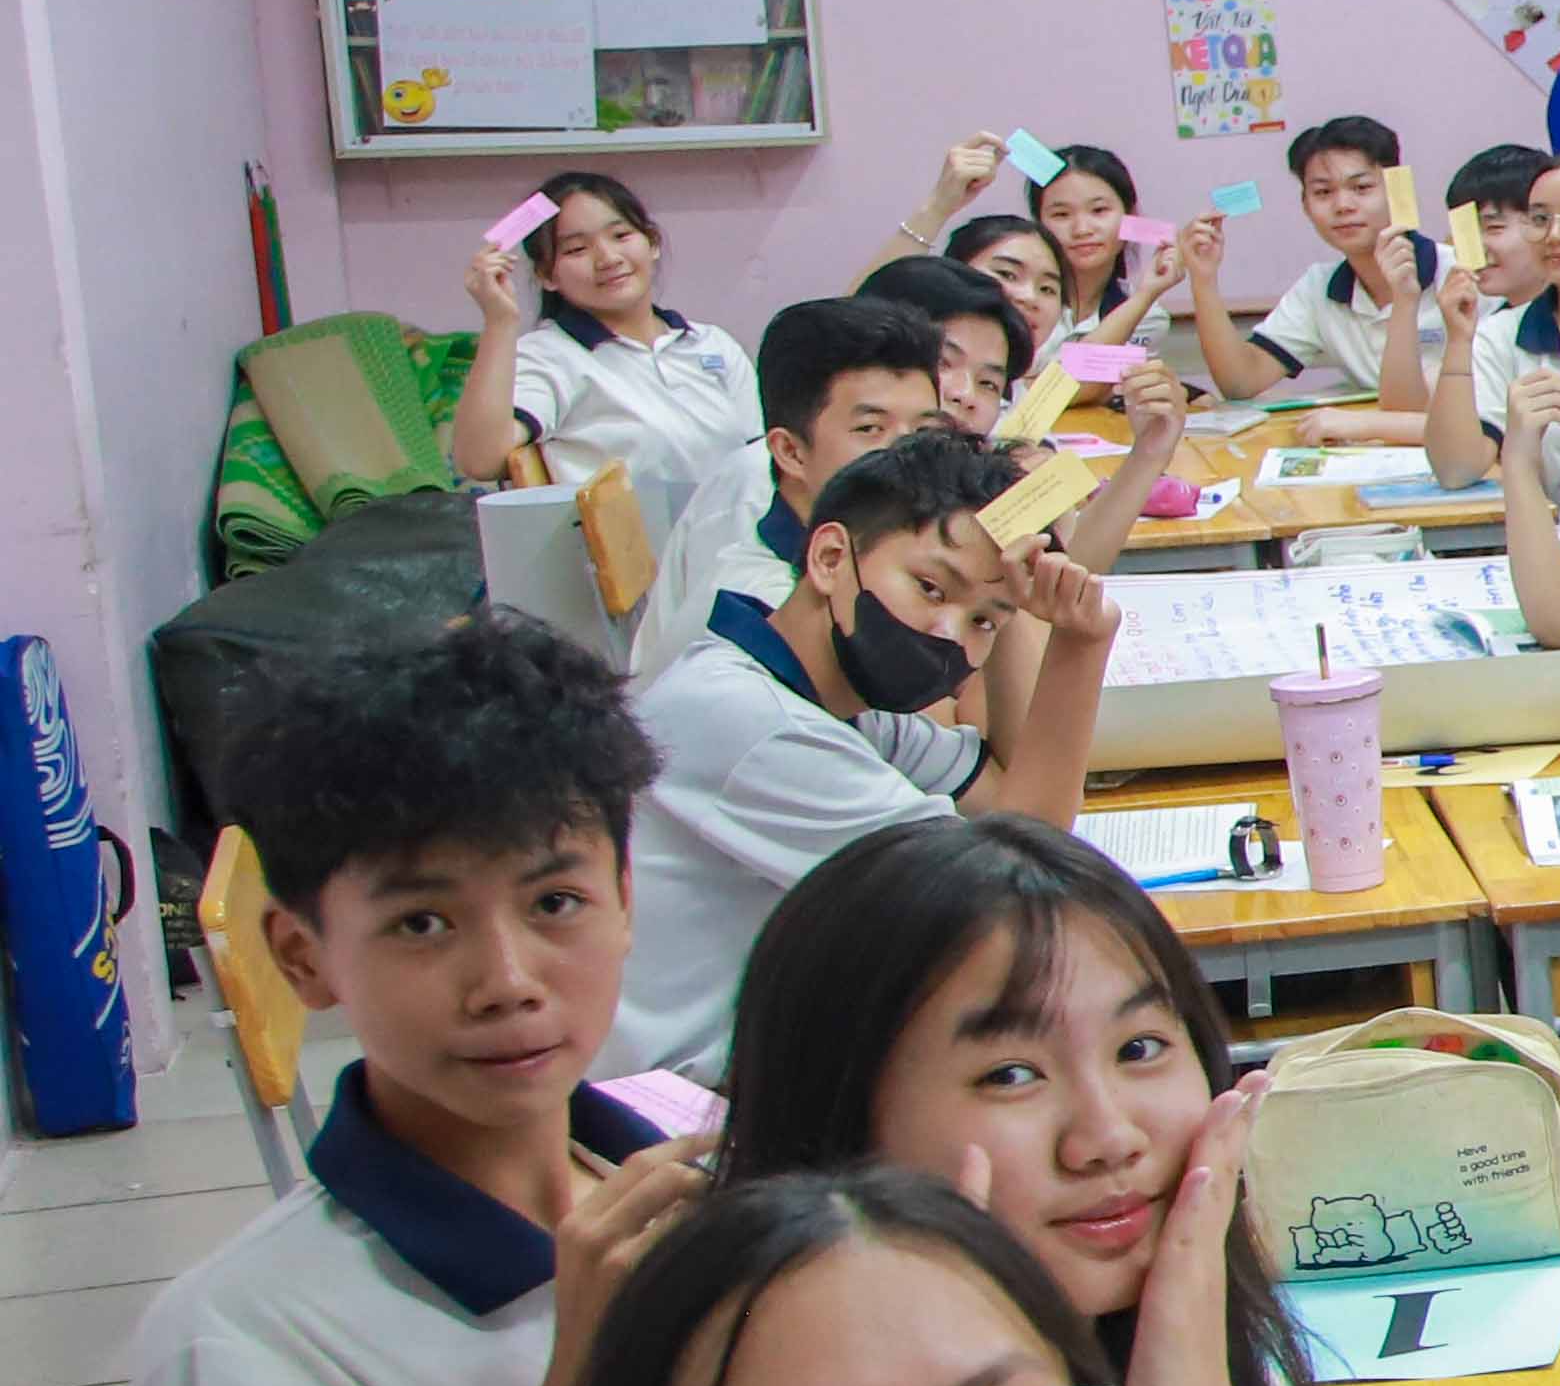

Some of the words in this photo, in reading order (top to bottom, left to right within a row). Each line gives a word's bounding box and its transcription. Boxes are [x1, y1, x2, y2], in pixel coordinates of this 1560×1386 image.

[1457, 1144, 1487, 1158] Have
[1470, 1156, 1500, 1172] good
[1501, 1150, 1526, 1166] time
[1461, 1173, 1488, 1188] with
[1490, 1163, 1530, 1182] friends
